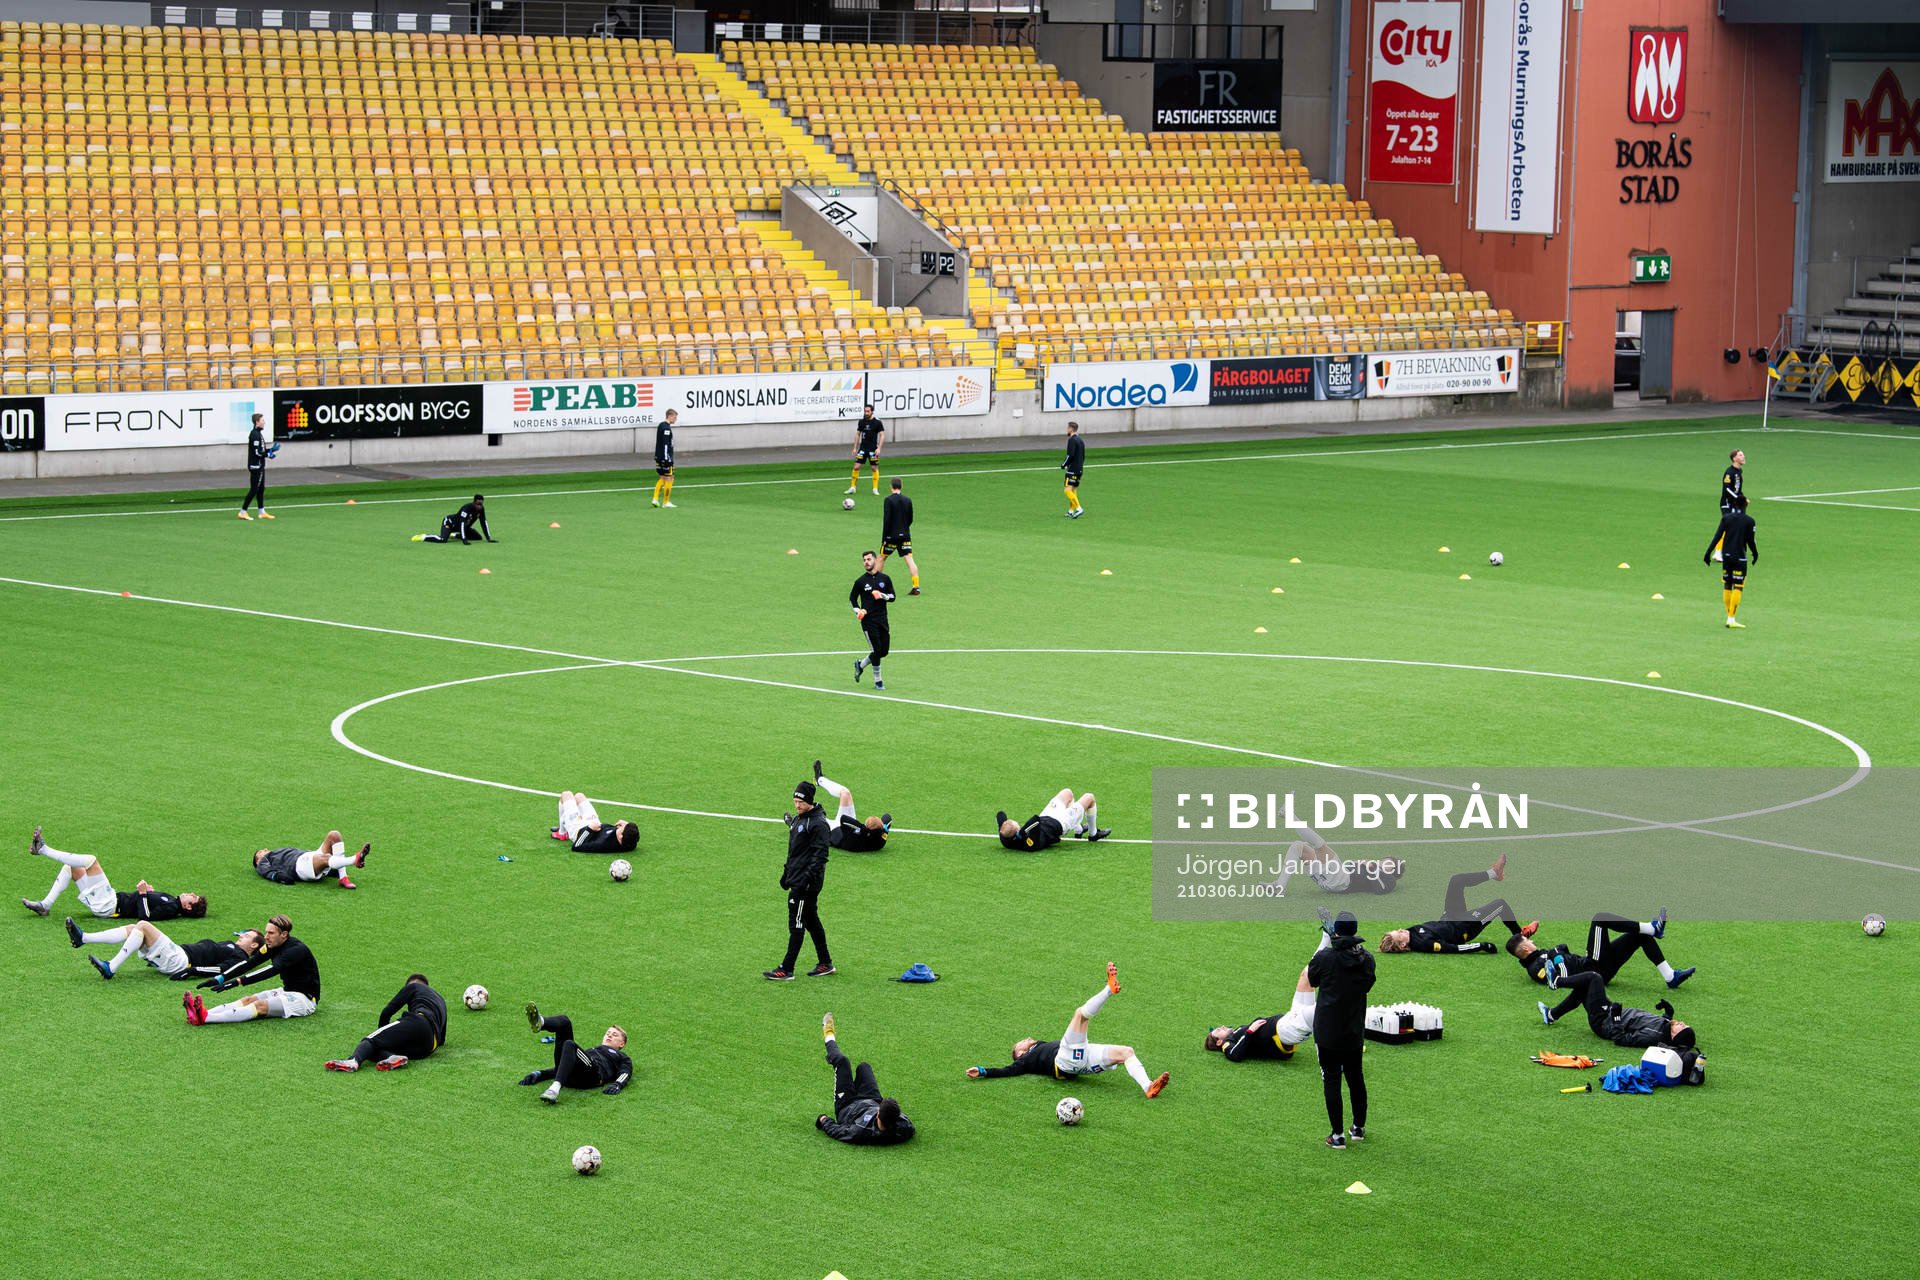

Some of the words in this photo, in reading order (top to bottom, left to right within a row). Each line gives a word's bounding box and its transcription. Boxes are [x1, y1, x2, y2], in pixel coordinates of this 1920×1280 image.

[1517, 0, 1532, 46] orås
[1380, 19, 1452, 66] City
[1425, 59, 1438, 68] ICA
[1198, 70, 1239, 106] FR
[1157, 109, 1277, 124] FASTIGHETSSERVICE
[1386, 108, 1407, 120] Öppet
[1407, 110, 1419, 119] alla
[1419, 109, 1440, 120] dagar
[1385, 124, 1439, 153] 7-23
[1511, 50, 1530, 221] MurningsArbeten
[1615, 131, 1693, 169] BORÅS
[1391, 155, 1417, 165] Julafton
[1417, 156, 1432, 165] 7-14
[1830, 163, 1886, 177] HAMBURGARE
[1886, 159, 1898, 176] PÅ
[1898, 162, 1920, 176] SVEN
[1619, 175, 1680, 204] STAD
[939, 255, 954, 272] P2
[1328, 363, 1352, 374] DEMI
[1396, 360, 1413, 375] 7H
[1416, 356, 1492, 374] BEVAKNING
[1213, 367, 1312, 386] FÄRGBOLAGET
[1328, 374, 1352, 385] DEKK
[1446, 379, 1471, 388] 020-90
[1472, 378, 1481, 387] 00
[1482, 377, 1492, 386] 90
[529, 383, 637, 412] PEAB
[686, 388, 788, 409] SIMONSLAND
[872, 388, 954, 411] ProFlow
[1055, 378, 1166, 409] Nordea
[1230, 387, 1274, 396] FÄRGBUTIK
[1283, 385, 1308, 394] BORÅS
[794, 397, 806, 406] THE
[807, 396, 835, 405] CREATIVE
[836, 395, 862, 404] FACTORY
[65, 408, 213, 434] FRONT
[315, 402, 414, 424] OLOFSSON
[420, 401, 471, 420] BYGG
[838, 406, 863, 417] KANICO
[513, 418, 558, 428] NORDENS
[561, 415, 653, 427] SAMHÄLLSBYGGARE
